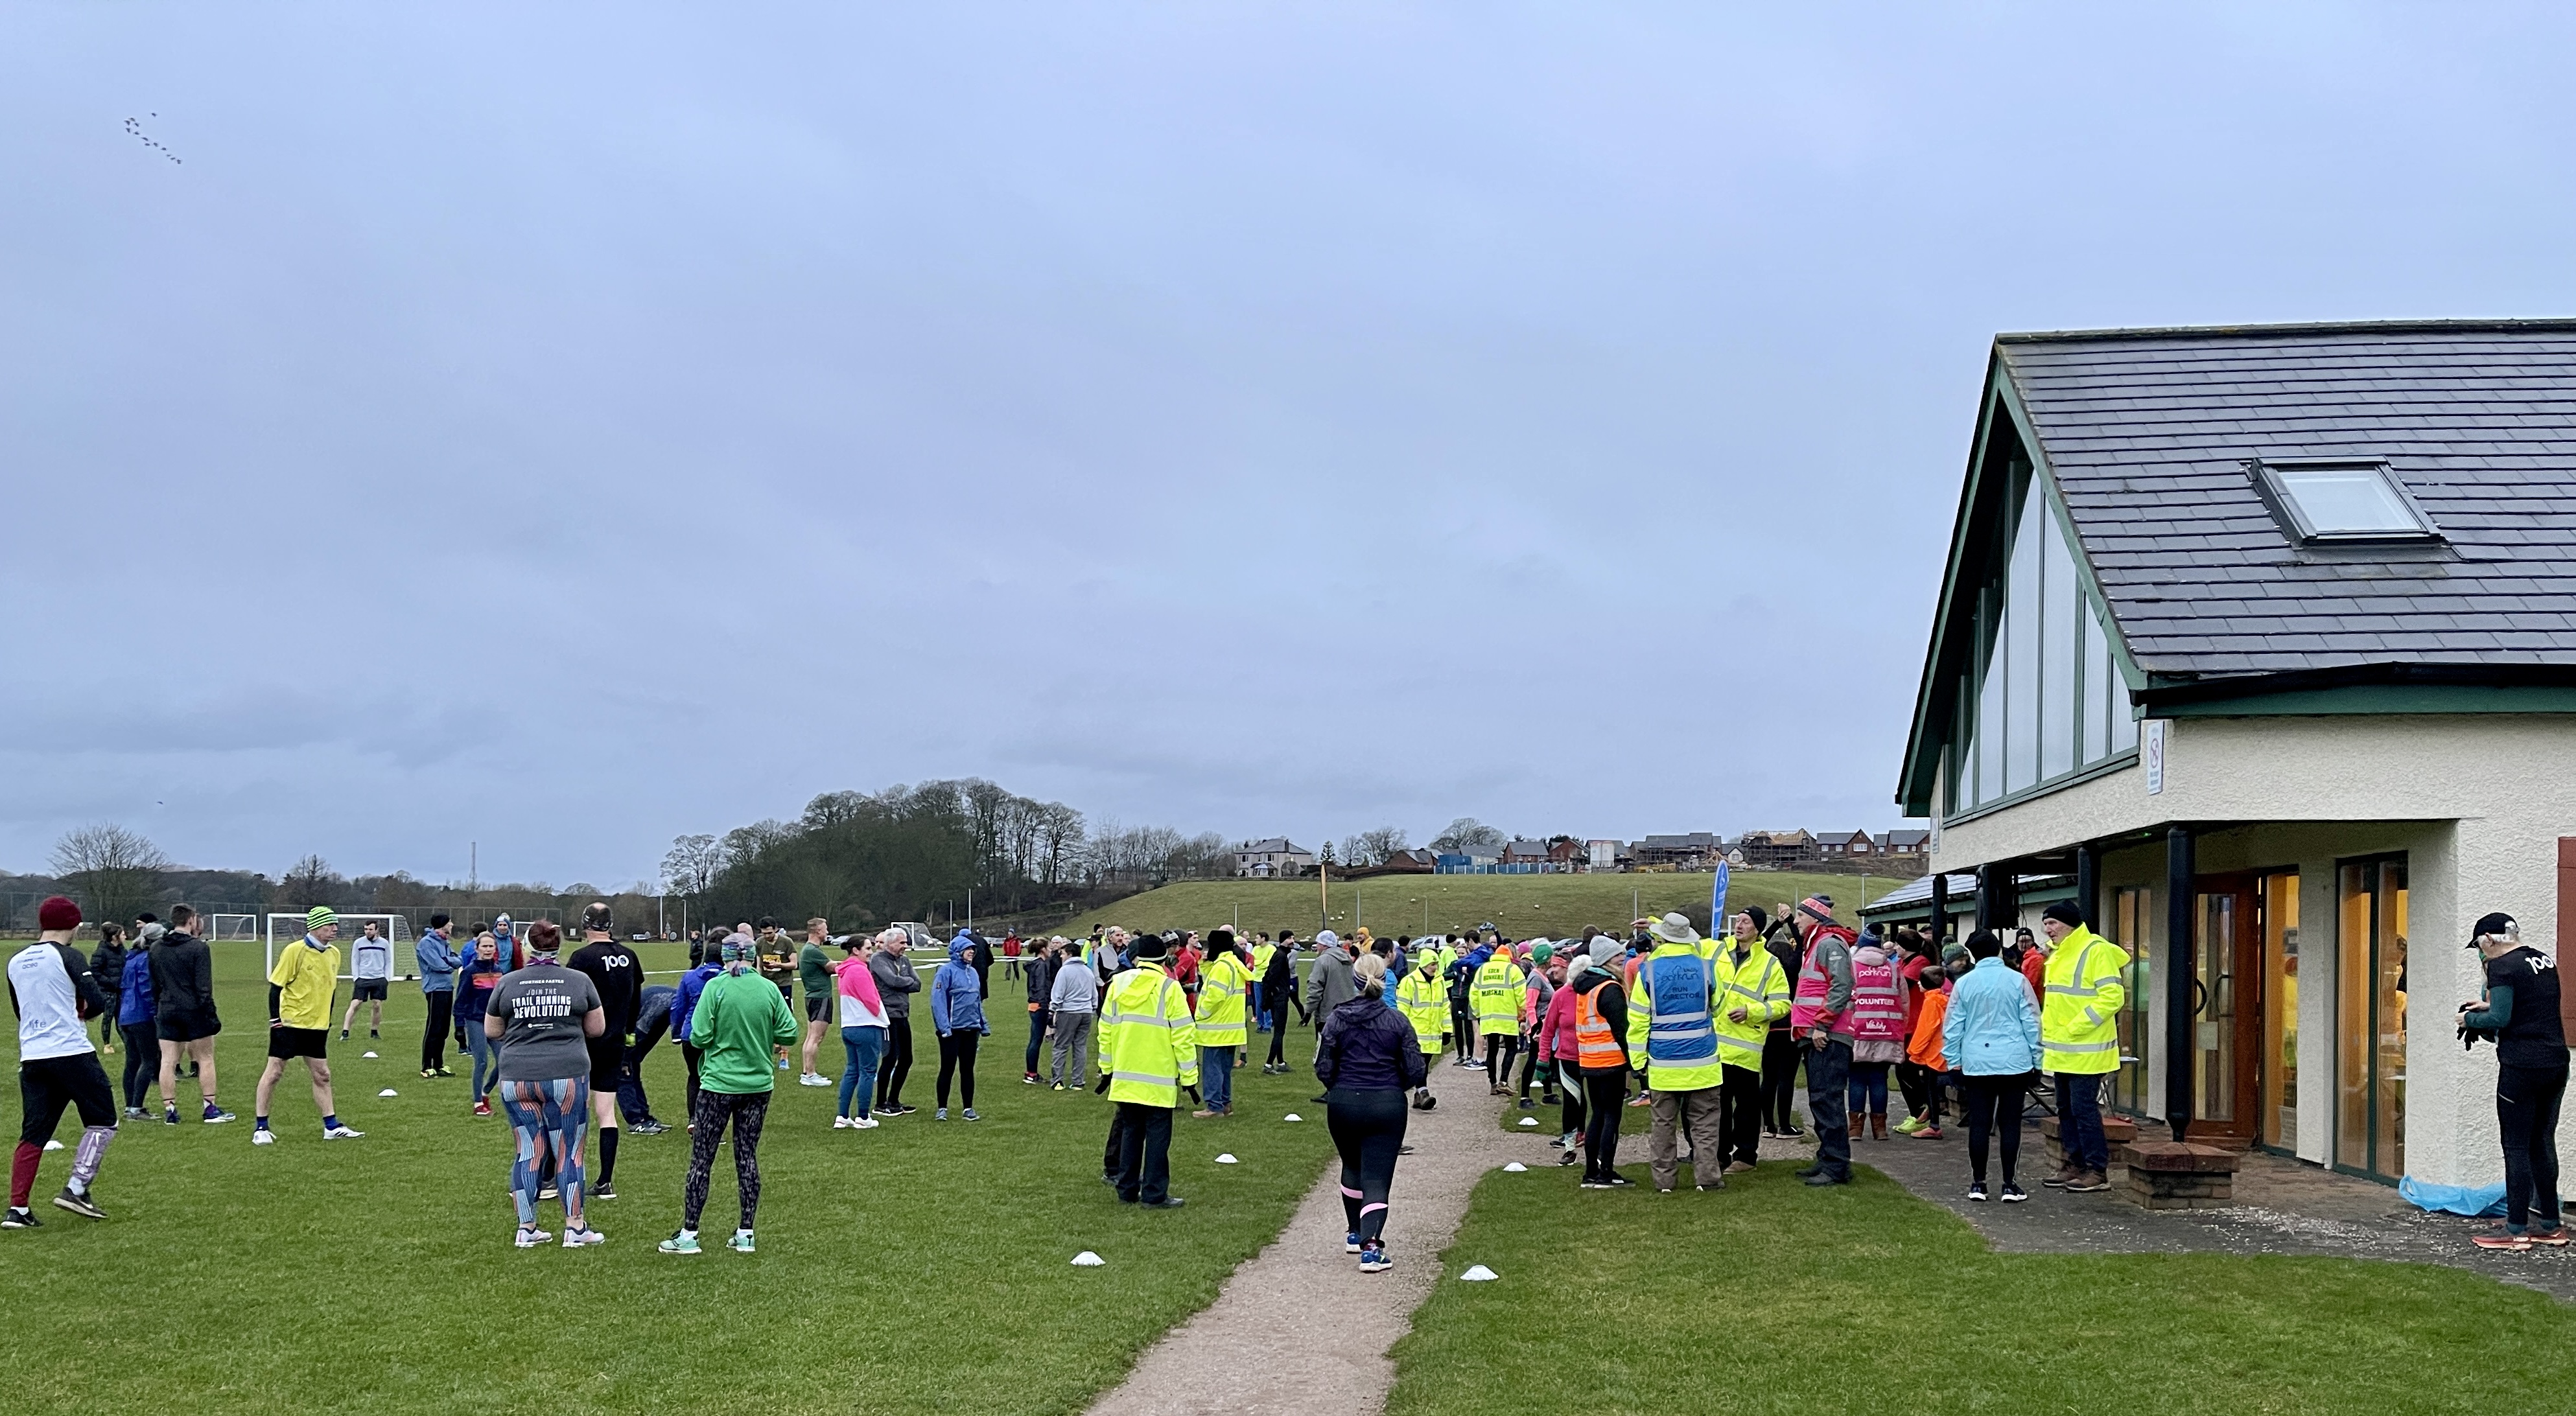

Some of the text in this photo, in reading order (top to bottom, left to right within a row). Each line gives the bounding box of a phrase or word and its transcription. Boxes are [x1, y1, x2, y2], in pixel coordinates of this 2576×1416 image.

[602, 955, 629, 971] 100
[2525, 955, 2554, 974] 100
[1660, 968, 1699, 983] parkrun
[1858, 966, 1891, 977] parkrun
[511, 995, 571, 1008] TRAIL RUNNING
[513, 1005, 570, 1019] REVOLUTION
